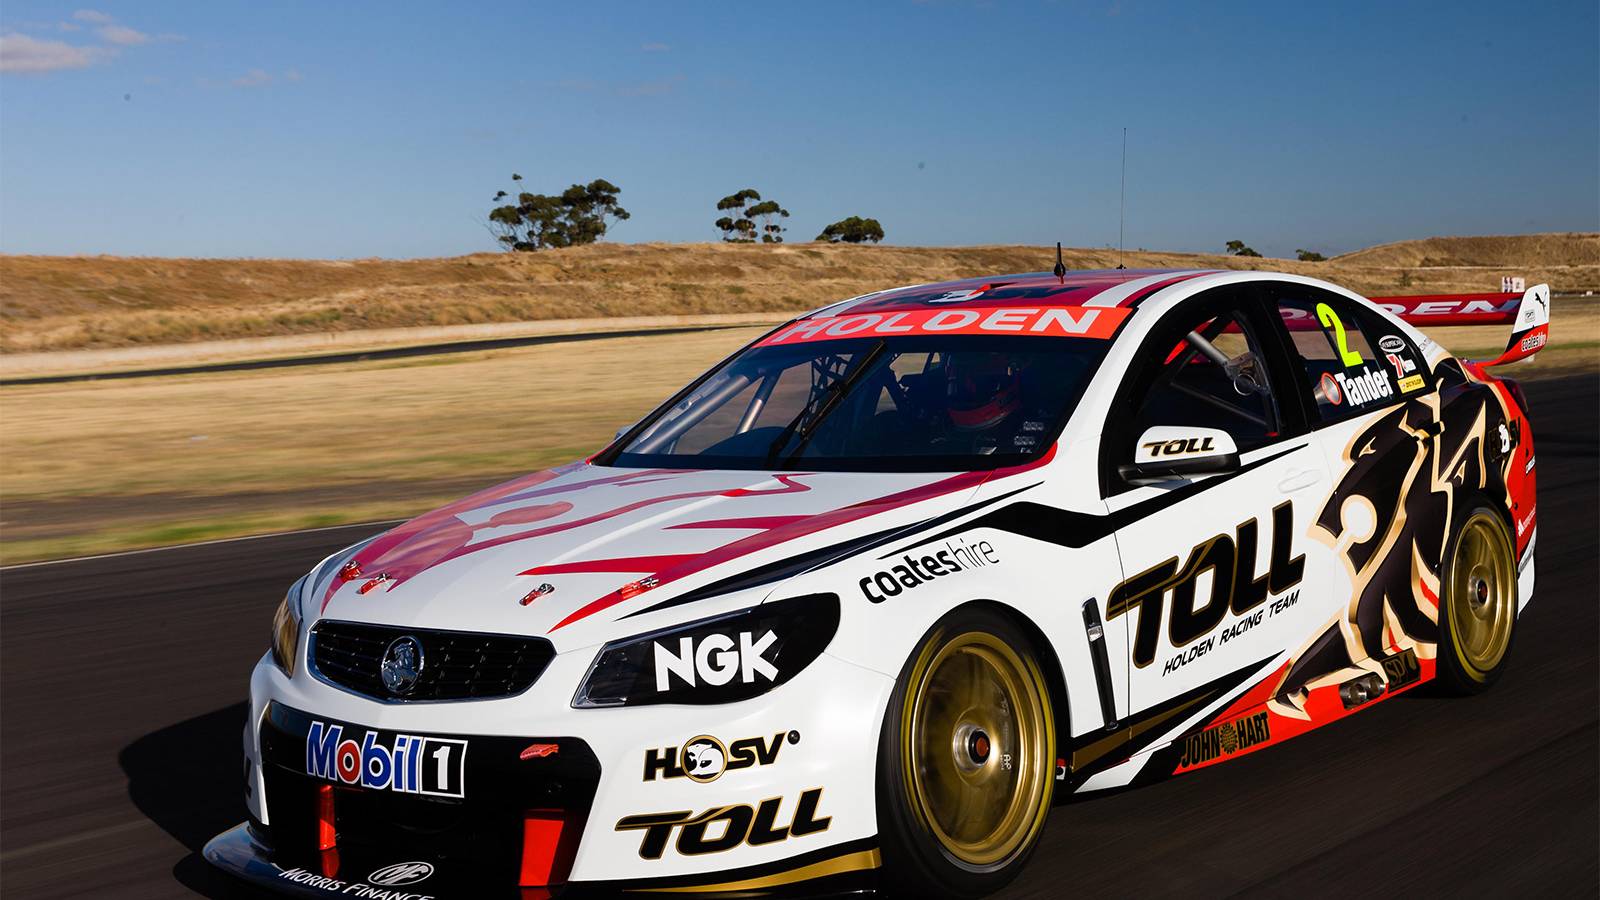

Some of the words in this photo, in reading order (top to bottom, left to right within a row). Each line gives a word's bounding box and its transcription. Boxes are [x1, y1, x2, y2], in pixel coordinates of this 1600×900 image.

[771, 308, 1102, 343] HOLDEN
[1316, 303, 1363, 367] 2
[1335, 365, 1394, 407] Tander
[1142, 437, 1215, 456] TOLL
[1105, 500, 1307, 669] TOLL
[654, 629, 780, 692] NGK
[1162, 636, 1216, 677] HOLDEN
[1219, 611, 1263, 646] RACING
[1269, 589, 1301, 618] TEAM
[306, 721, 422, 794] Mobil
[432, 746, 451, 790] 1
[1181, 727, 1221, 768] JOHN
[1235, 711, 1270, 749] HART
[614, 785, 833, 861] TOLL
[278, 867, 348, 891] MORRIS
